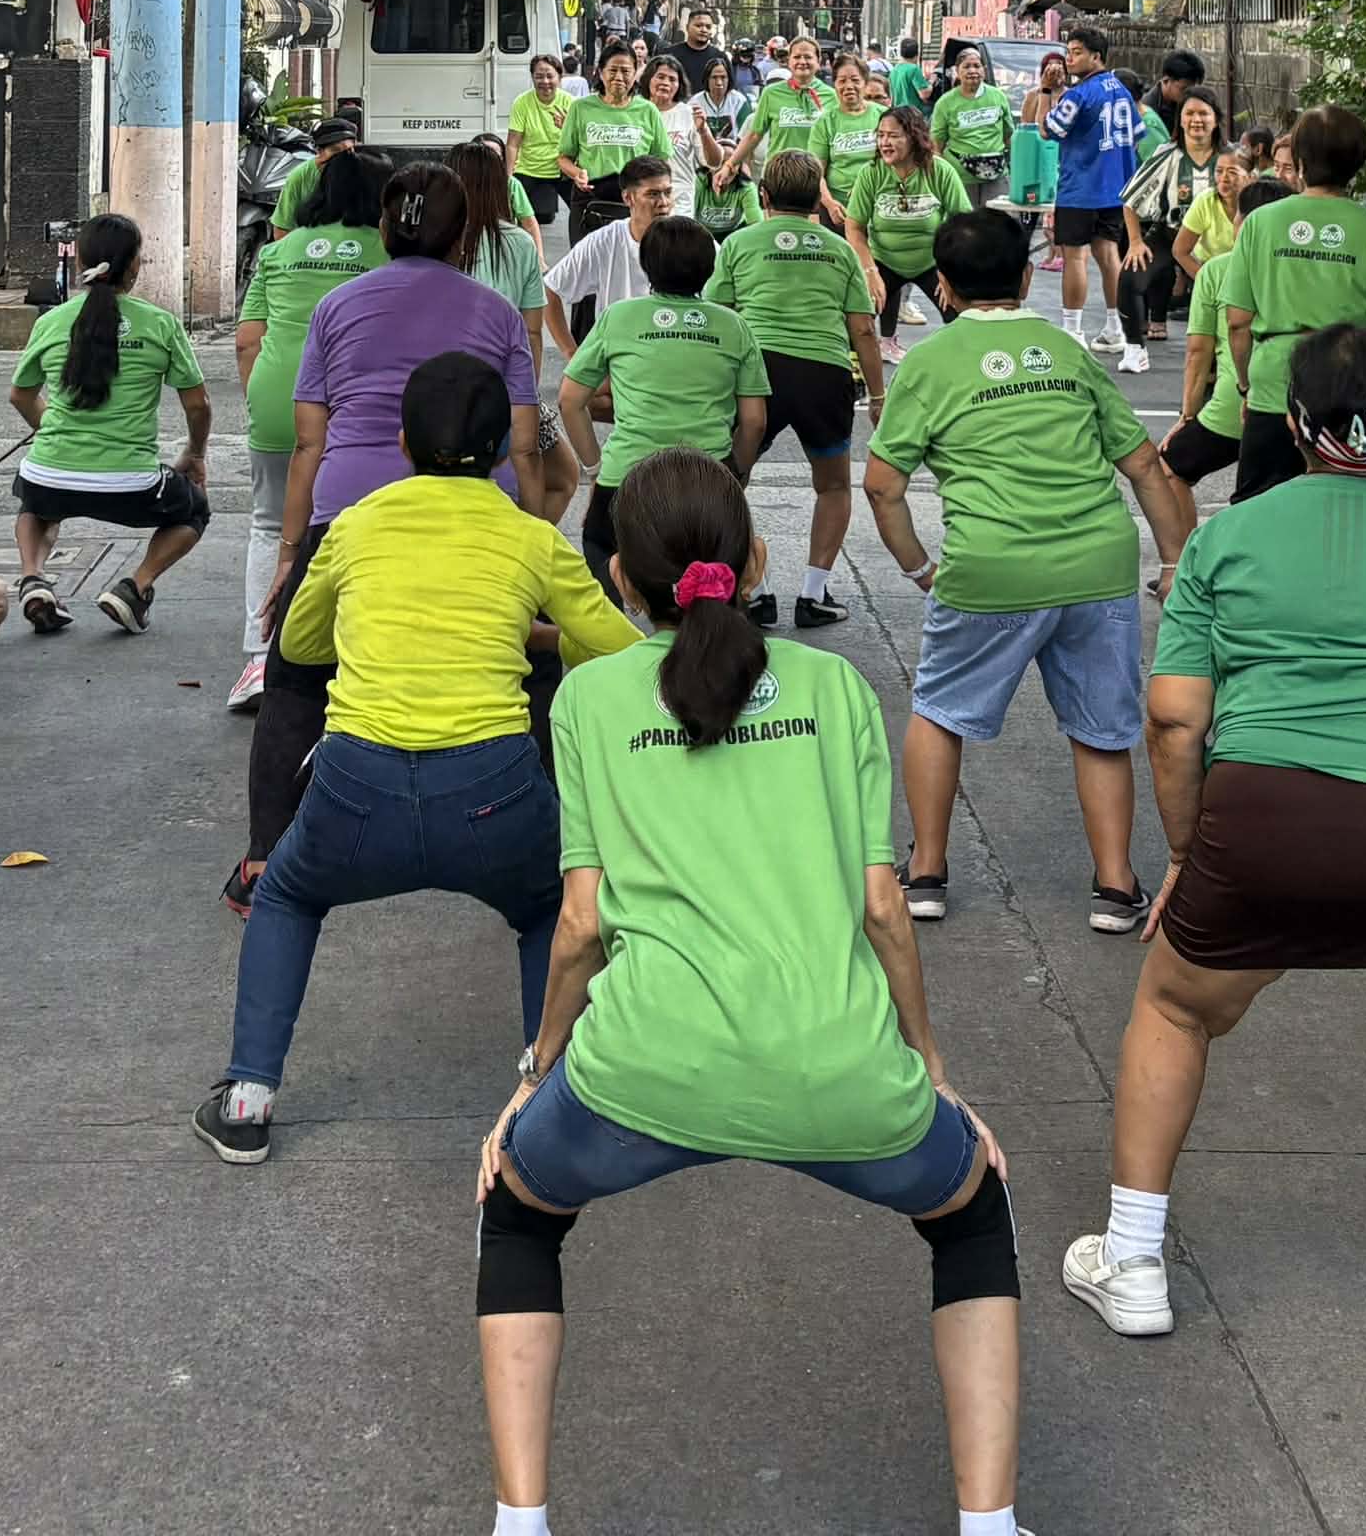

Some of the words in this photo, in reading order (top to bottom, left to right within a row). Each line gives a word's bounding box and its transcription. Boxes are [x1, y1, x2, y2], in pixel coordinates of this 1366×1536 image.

[402, 119, 422, 129] KEEP
[424, 119, 462, 129] DISTANCE
[1099, 97, 1134, 151] 19
[971, 378, 1078, 406] #PARASAPOBLACION
[628, 717, 817, 753] #PARAOBLACION
